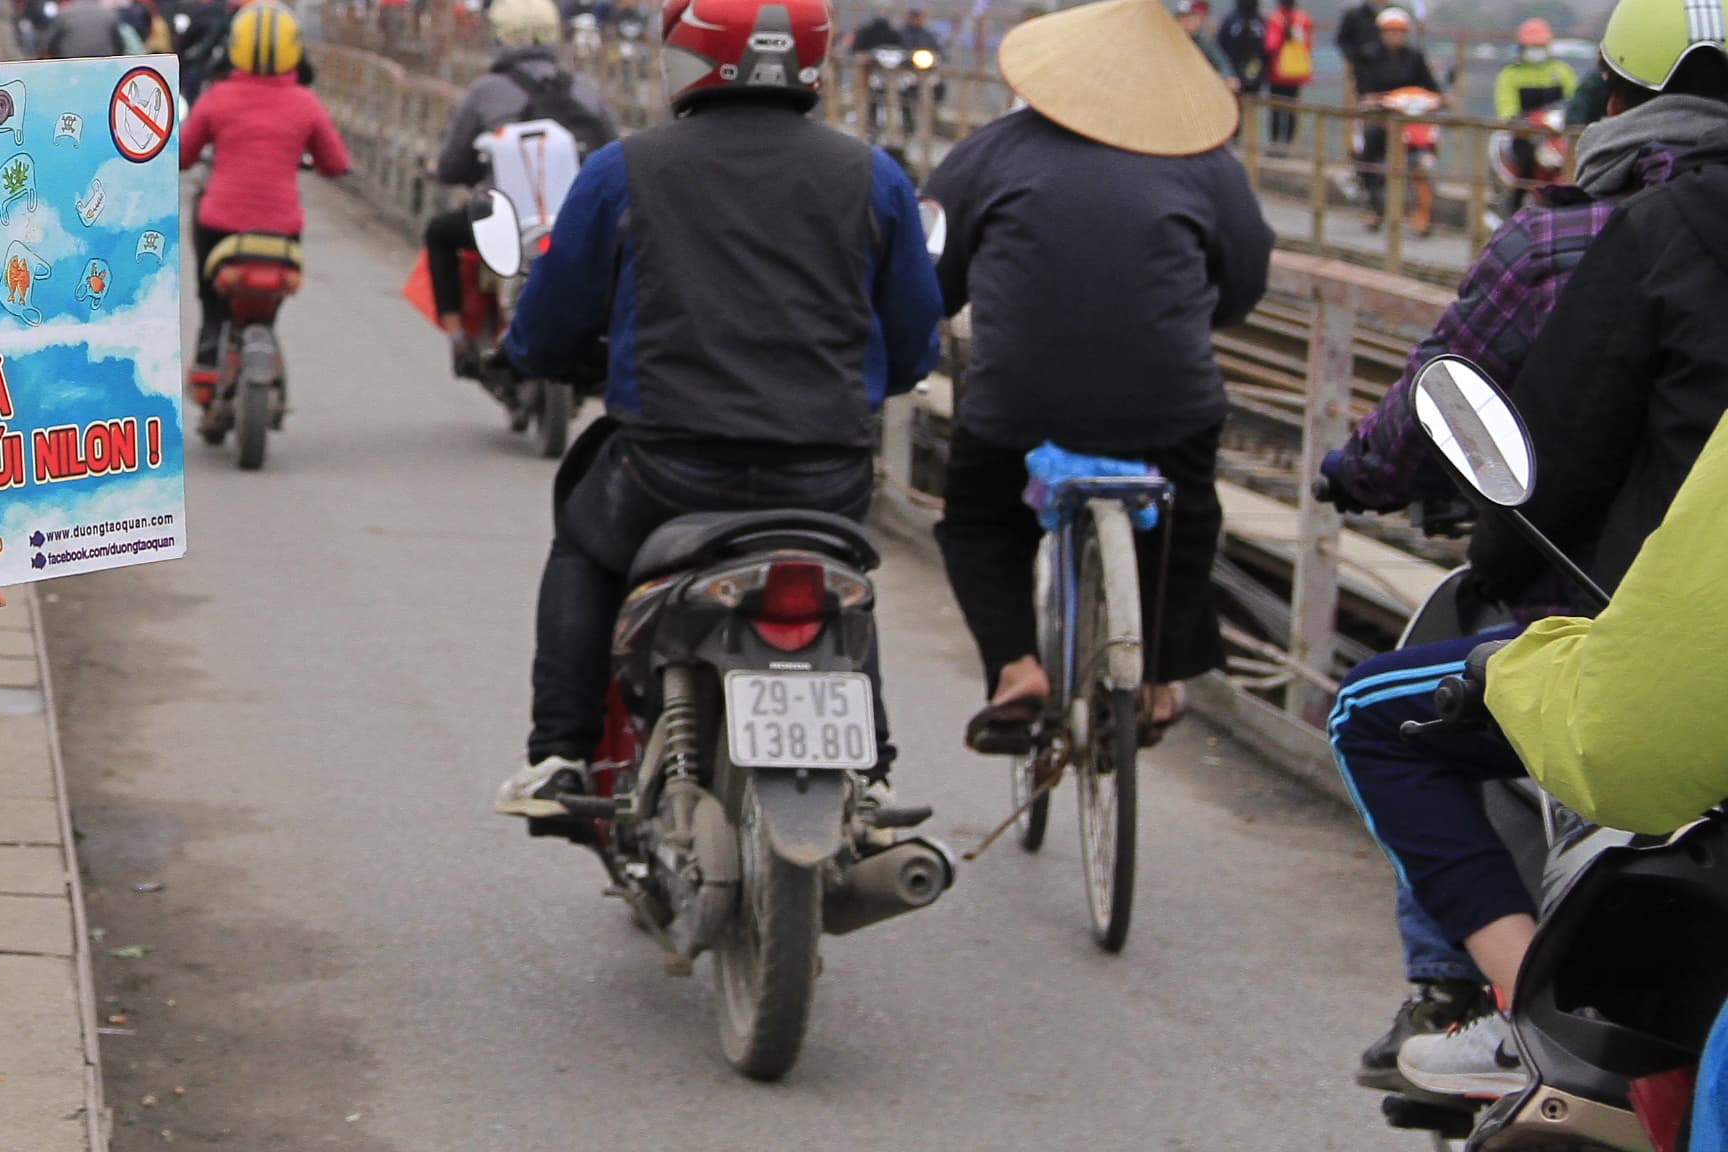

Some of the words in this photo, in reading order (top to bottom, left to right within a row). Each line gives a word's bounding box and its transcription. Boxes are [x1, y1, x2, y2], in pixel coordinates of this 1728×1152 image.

[33, 420, 136, 482] NILON
[46, 513, 173, 542] www.duongtaoquan.com
[48, 536, 175, 565] facebook.com/duongtaoquan
[749, 679, 849, 718] 29-V5
[743, 722, 865, 760] 138.80
